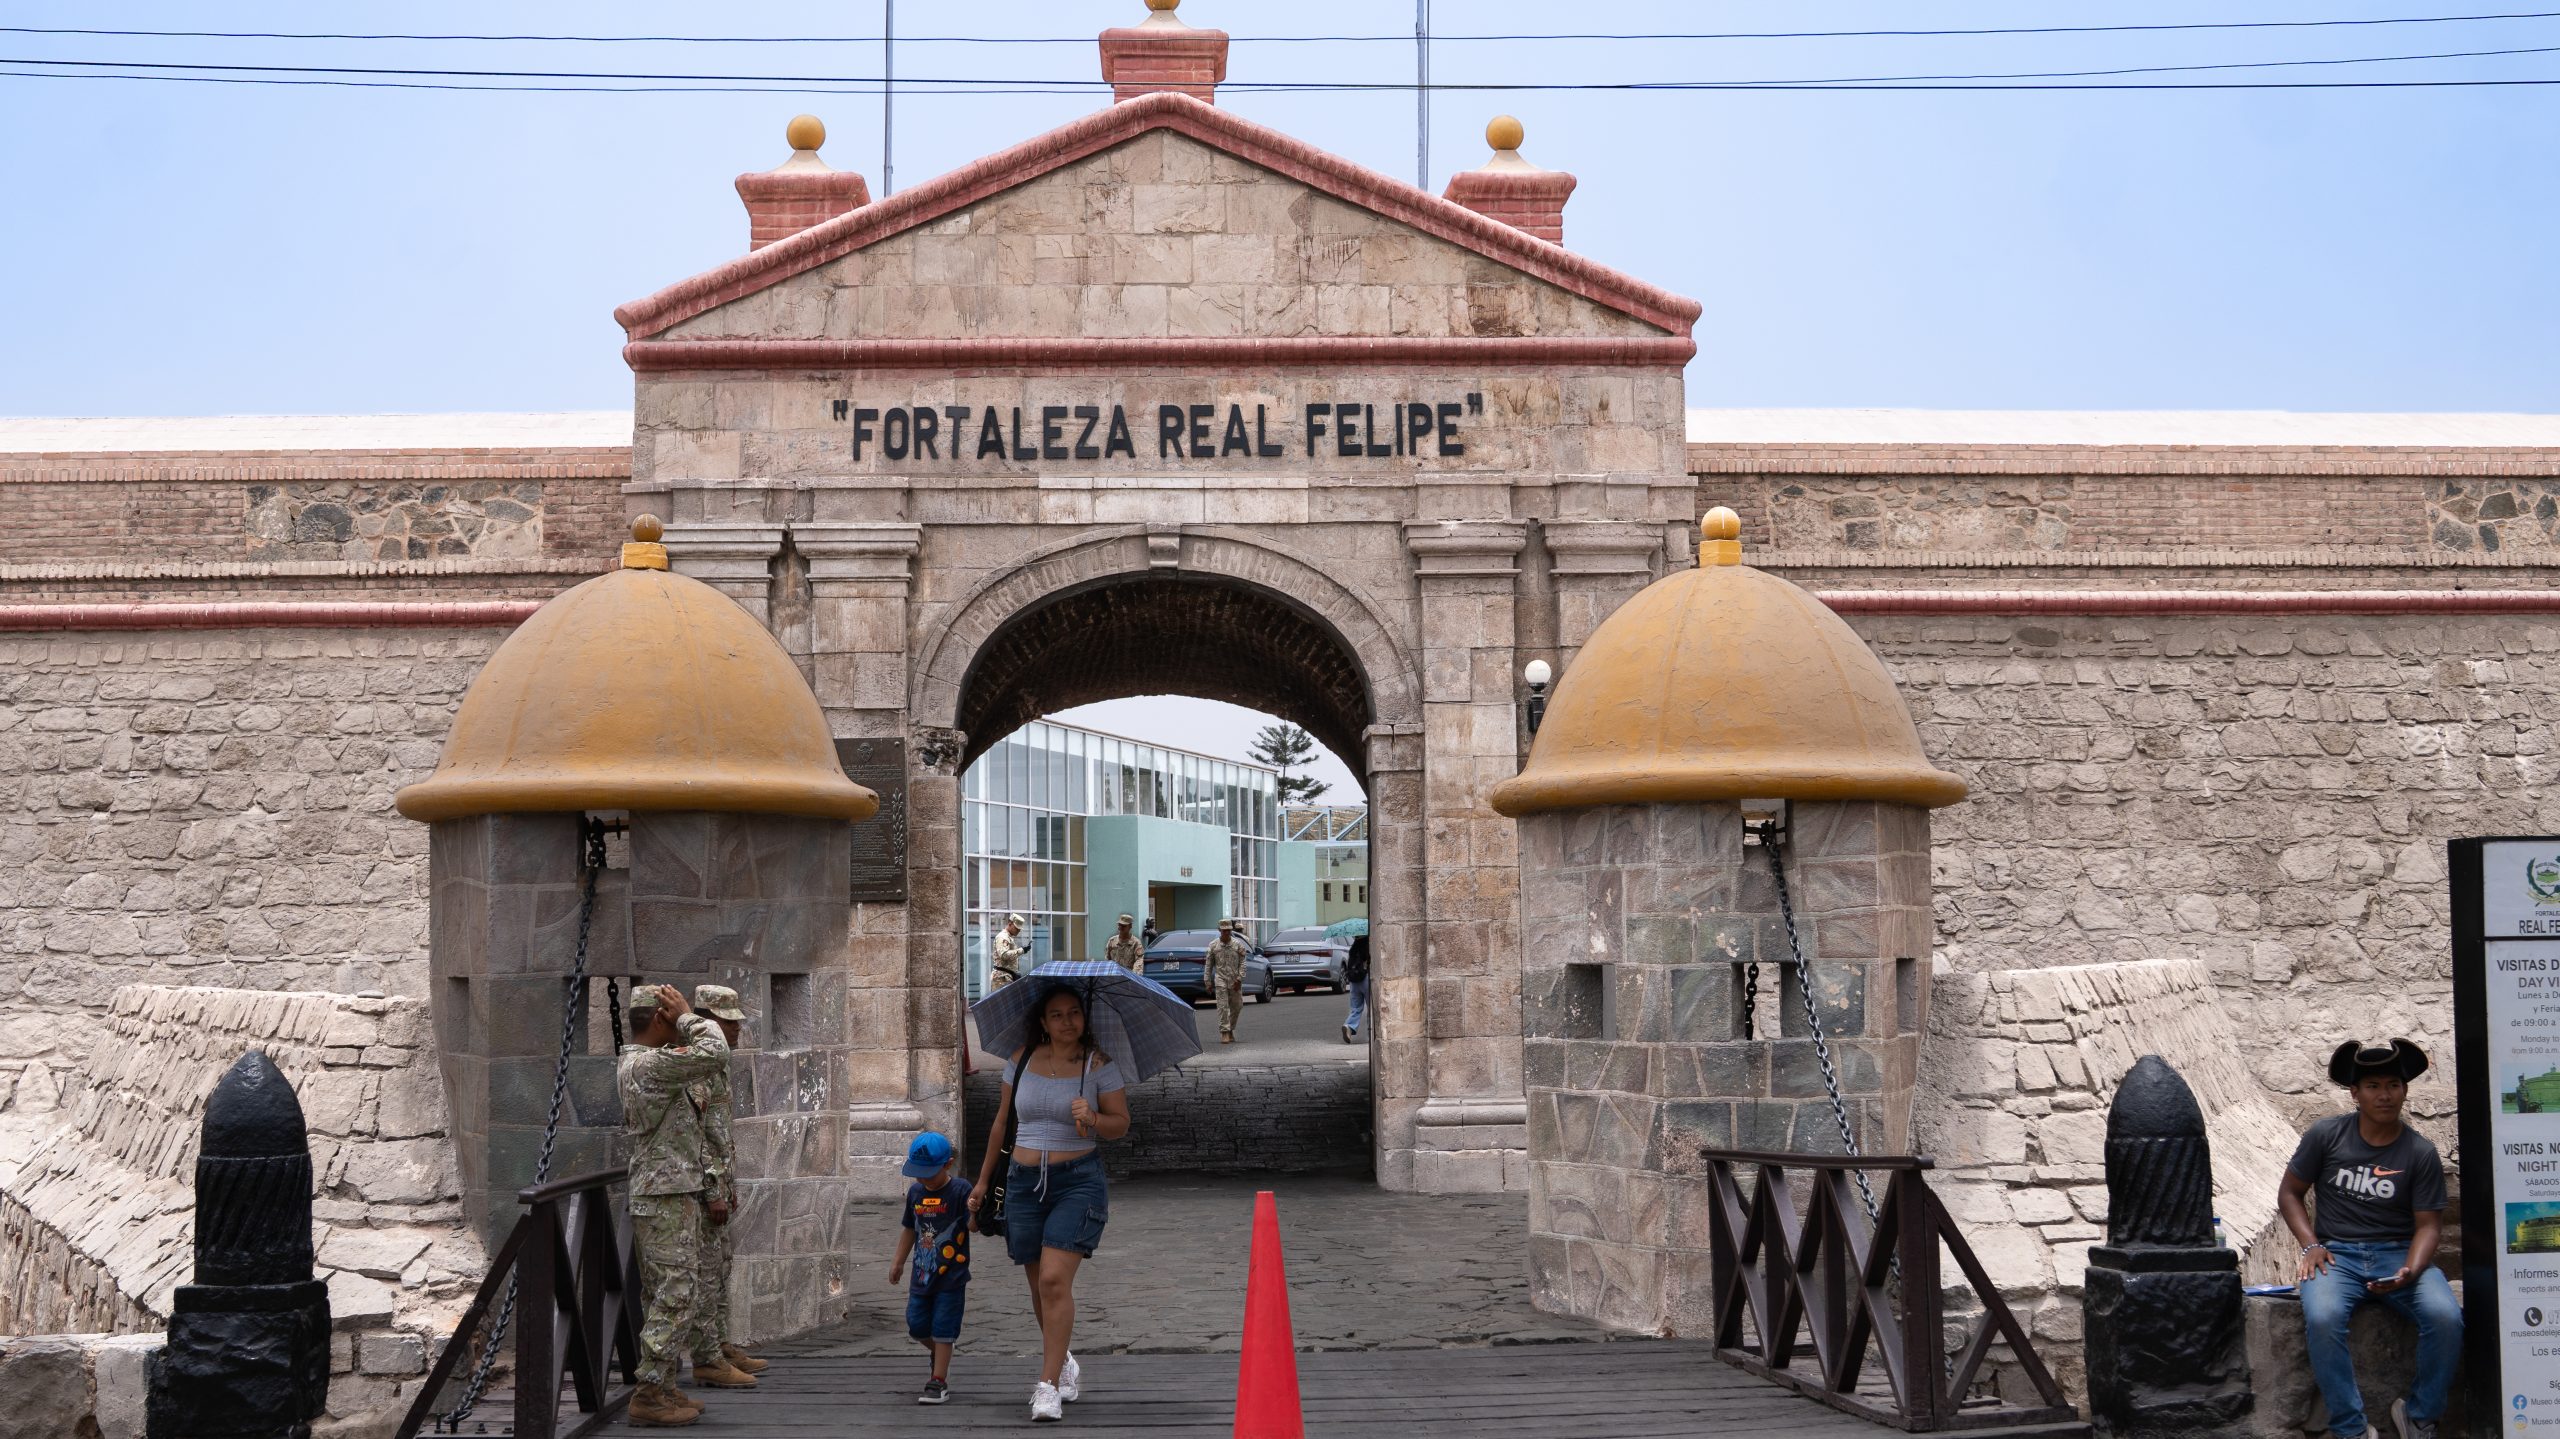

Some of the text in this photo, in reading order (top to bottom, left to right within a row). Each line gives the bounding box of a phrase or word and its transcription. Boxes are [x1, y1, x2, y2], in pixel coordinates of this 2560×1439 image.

[1159, 403, 1283, 457] REAL
[2519, 920, 2546, 934] REAL
[2496, 959, 2546, 971] VISITAS
[2519, 977, 2544, 988] DAY
[2511, 1019, 2521, 1027] de
[2524, 1018, 2549, 1027] 09:00
[2520, 1035, 2550, 1044] Monday
[2502, 1143, 2544, 1156] VISITAS
[2517, 1160, 2558, 1172] NIGHT
[2335, 1165, 2396, 1199] nike
[2524, 1178, 2560, 1186] SÁBADOS
[2513, 1268, 2559, 1279] Informes
[2518, 1286, 2546, 1294] reports
[2531, 1346, 2549, 1357] Los
[2530, 1398, 2553, 1406] Museo
[2531, 1418, 2554, 1426] Museo
